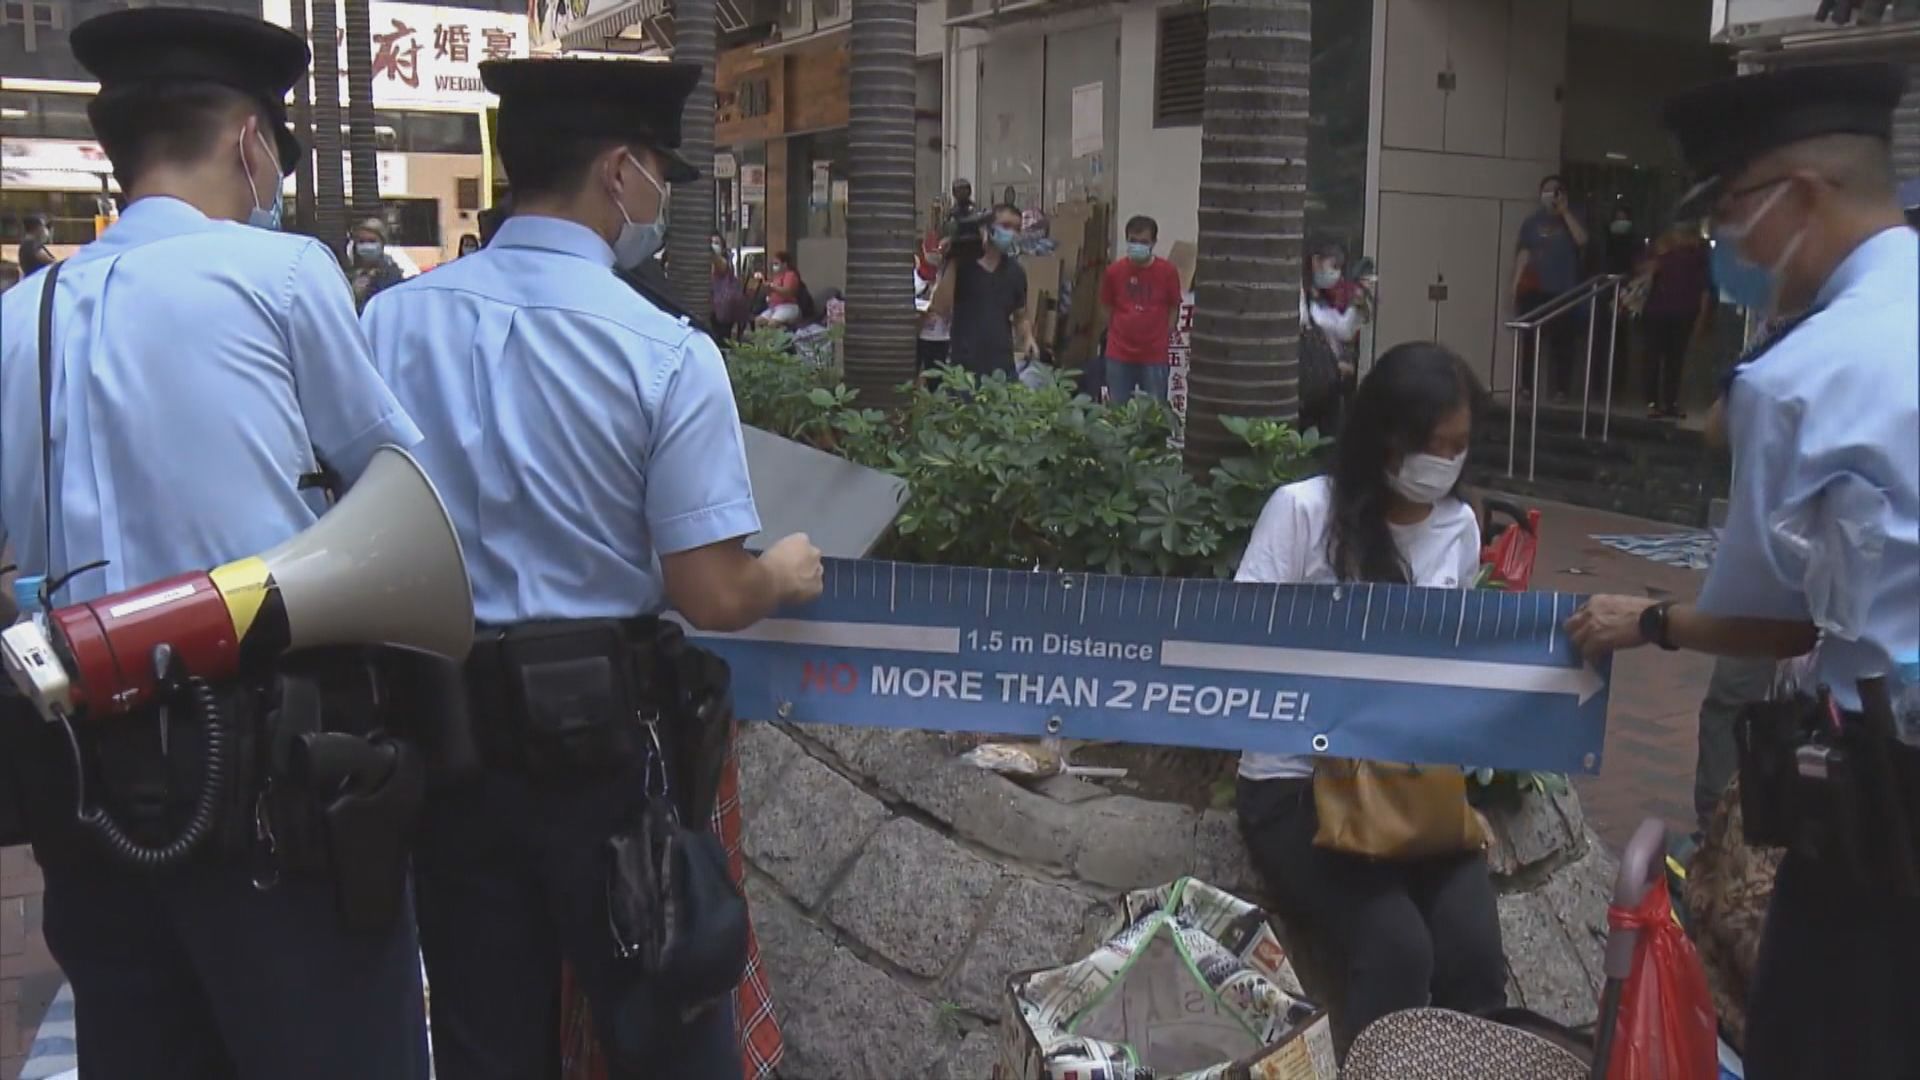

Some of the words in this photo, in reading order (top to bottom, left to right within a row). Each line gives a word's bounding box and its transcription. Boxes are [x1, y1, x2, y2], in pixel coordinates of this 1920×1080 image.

[434, 75, 485, 92] WEDDI
[967, 629, 1003, 652] 1.5
[1011, 635, 1033, 652] m
[1042, 633, 1153, 661] Distance
[801, 659, 859, 695] NO
[870, 665, 984, 701] MORE
[995, 672, 1099, 707] THAN
[1105, 679, 1137, 709] 2
[1142, 682, 1311, 722] PEOPLE!
